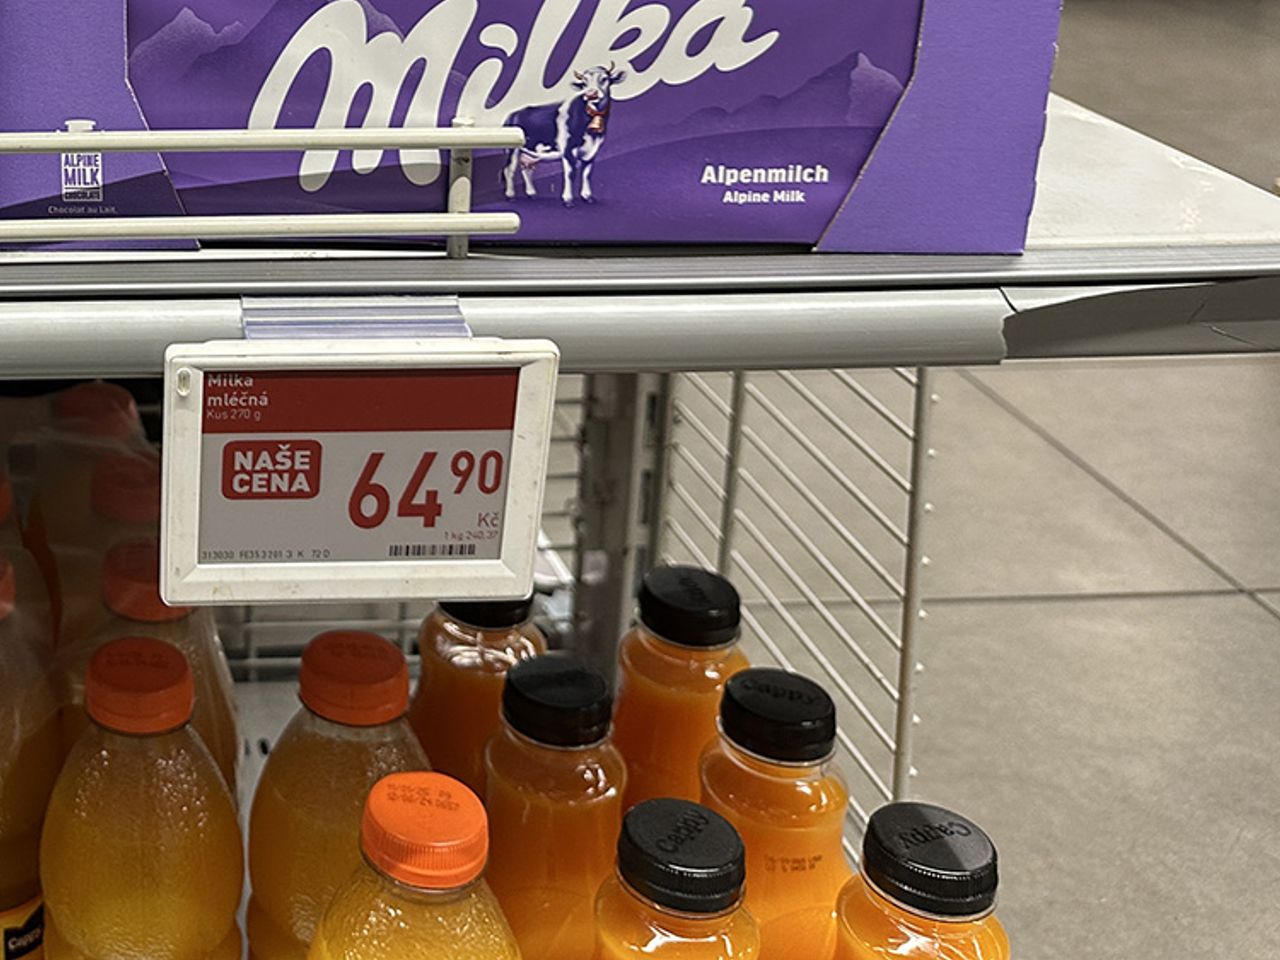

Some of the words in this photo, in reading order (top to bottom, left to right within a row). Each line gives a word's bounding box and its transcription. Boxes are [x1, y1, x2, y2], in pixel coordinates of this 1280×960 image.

[63, 153, 100, 167] ALPINE
[64, 168, 100, 186] MILK
[700, 163, 829, 186] Alpenmilch
[722, 189, 771, 205] Alpine
[772, 189, 807, 203] Milk
[207, 373, 254, 387] Milka
[207, 391, 269, 407] mléčná
[206, 409, 229, 420] Kus
[230, 408, 251, 420] 270
[254, 410, 262, 422] g
[232, 443, 311, 471] NAŠE
[231, 472, 311, 494] CENA
[477, 511, 500, 528] Kč
